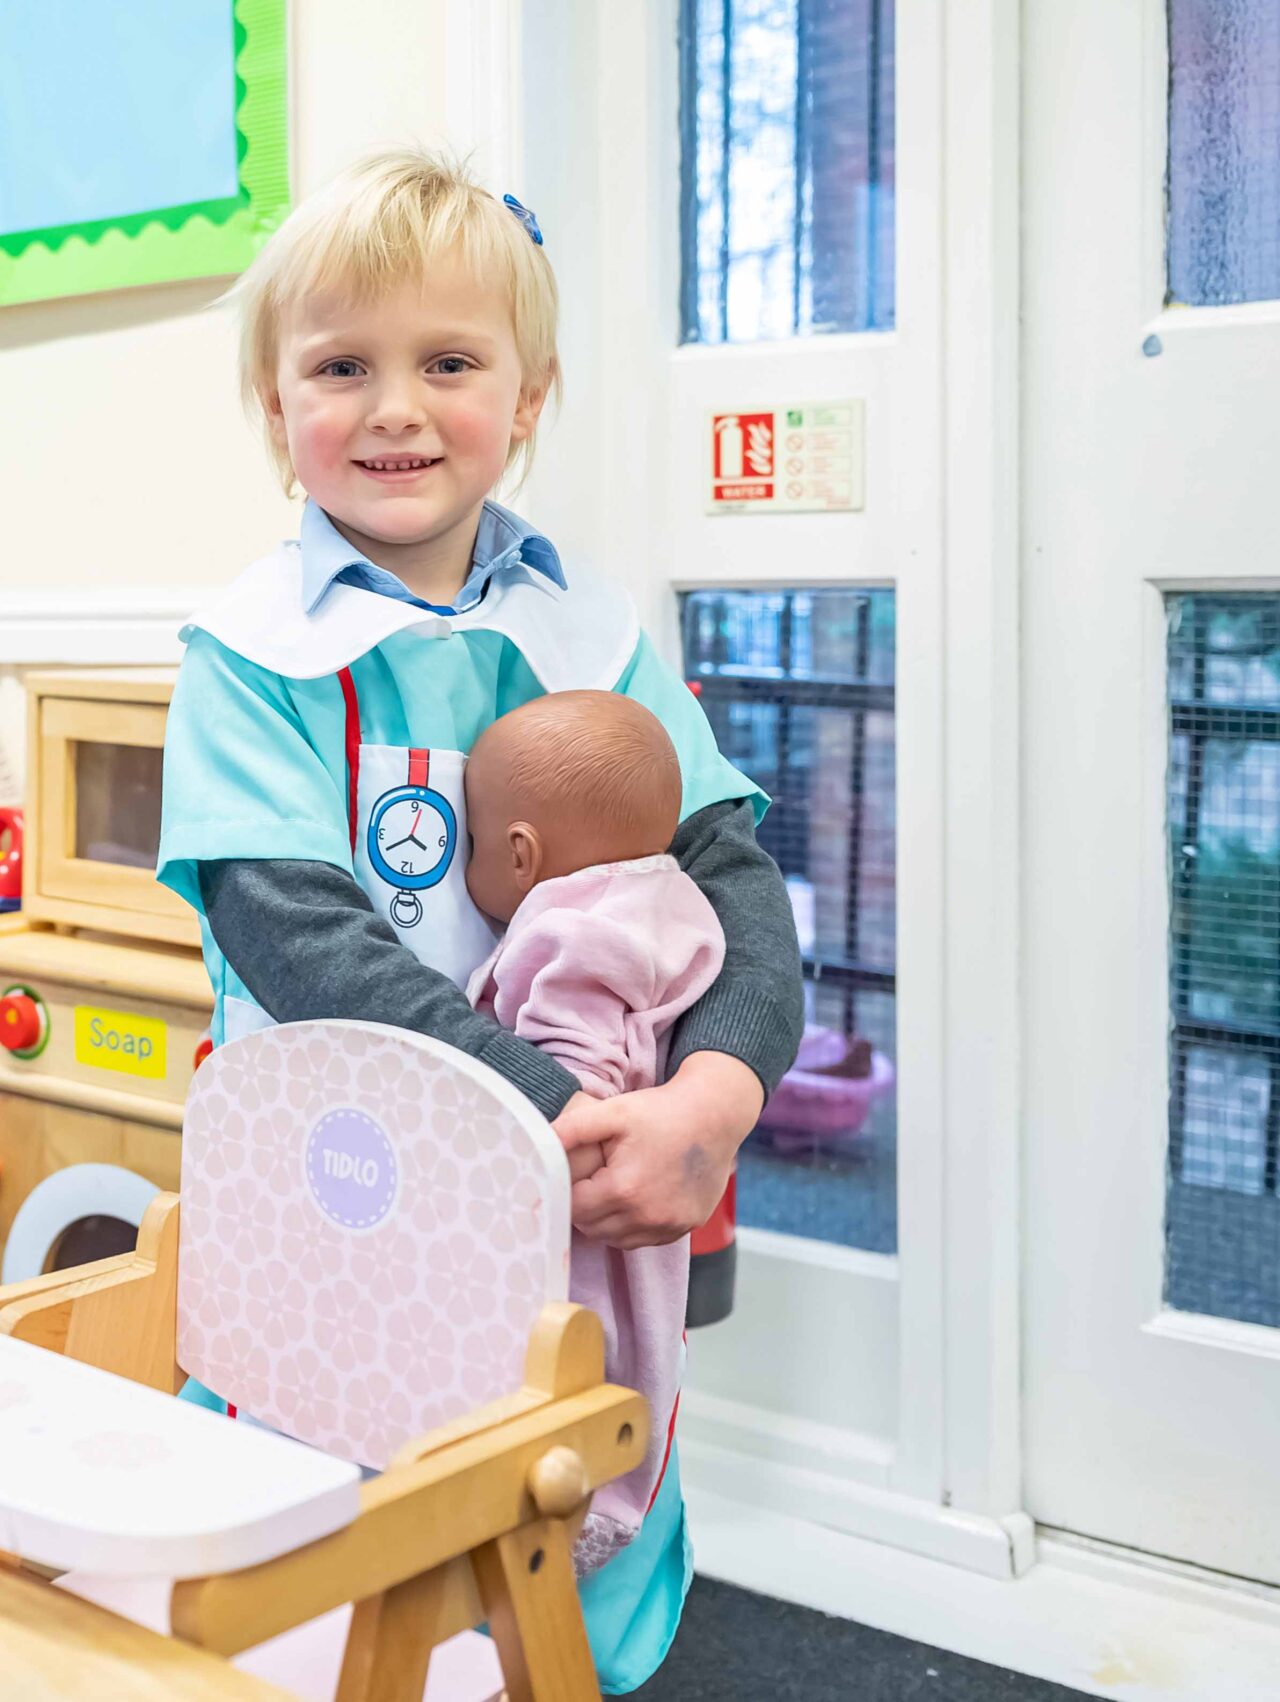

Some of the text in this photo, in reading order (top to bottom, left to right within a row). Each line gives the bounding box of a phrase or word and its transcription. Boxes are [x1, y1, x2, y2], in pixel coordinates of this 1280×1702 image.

[722, 486, 766, 498] WATER
[378, 828, 386, 840] 3
[400, 860, 414, 874] 12
[90, 1017, 153, 1063] Soap
[322, 1148, 378, 1188] TIDLO
